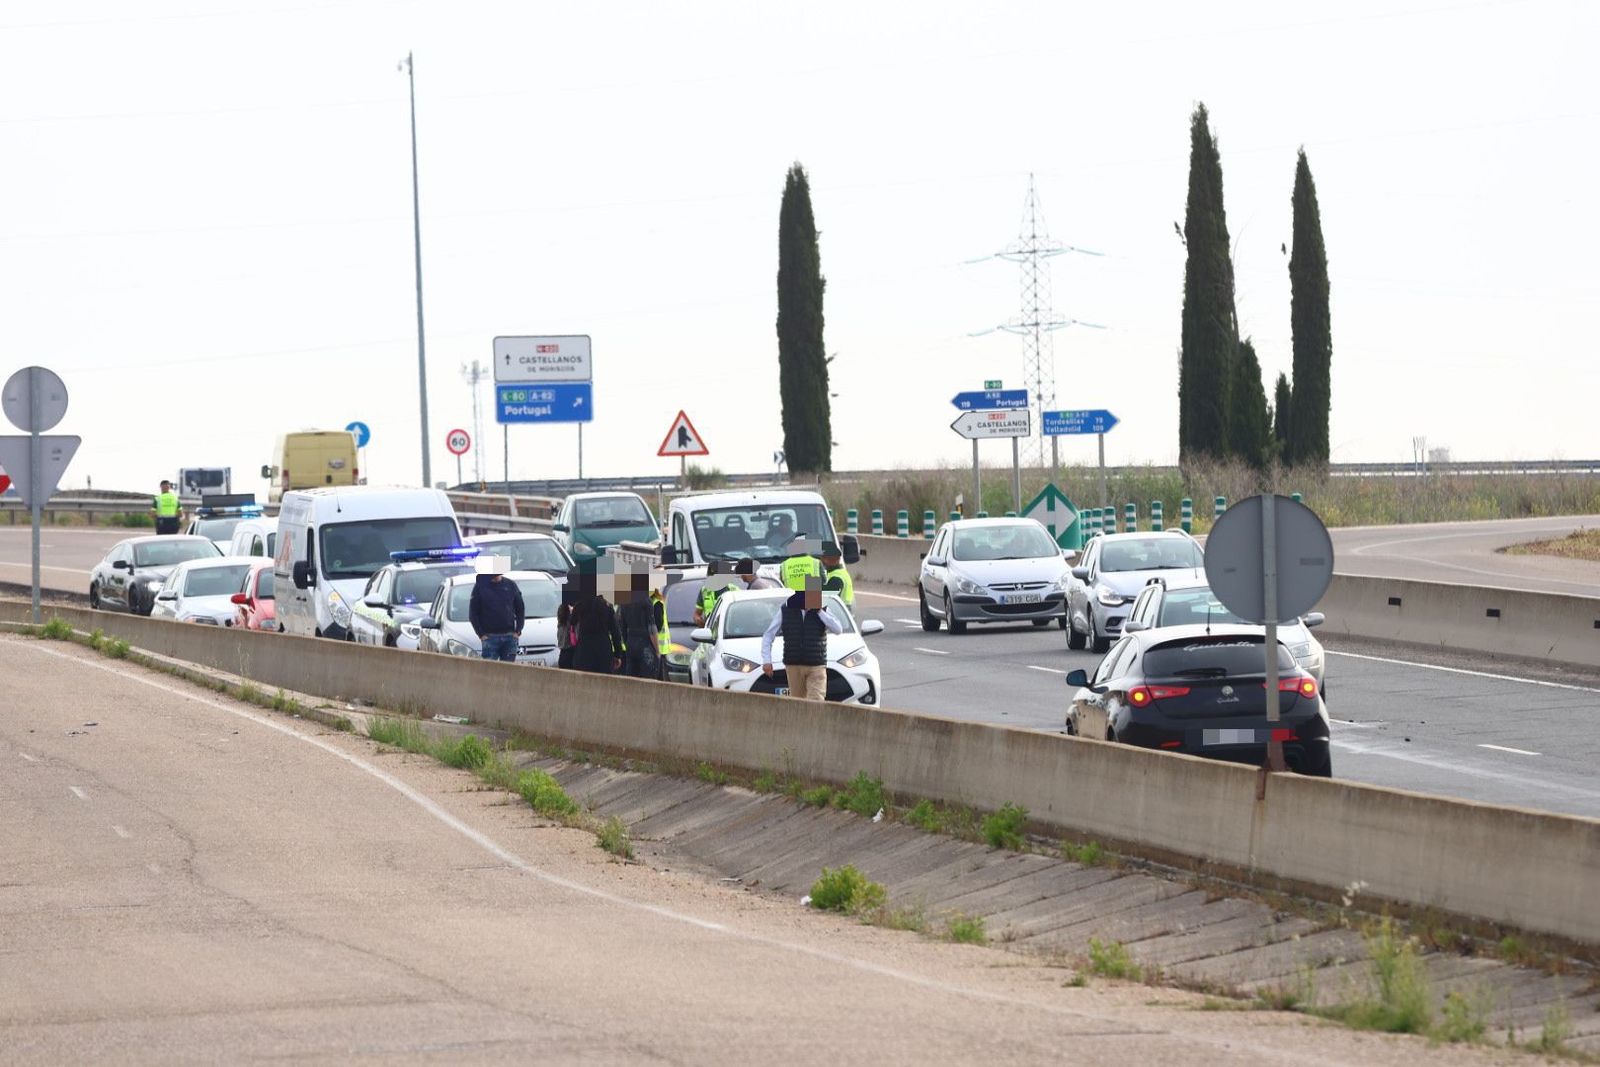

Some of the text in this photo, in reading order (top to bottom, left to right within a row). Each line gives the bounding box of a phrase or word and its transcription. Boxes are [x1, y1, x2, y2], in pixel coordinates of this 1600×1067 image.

[519, 356, 583, 364] CASTELLANOS
[995, 399, 1026, 407] Portugal
[504, 404, 552, 416] Portugal
[977, 420, 1027, 428] CASTELLANOS
[451, 437, 466, 447] 60
